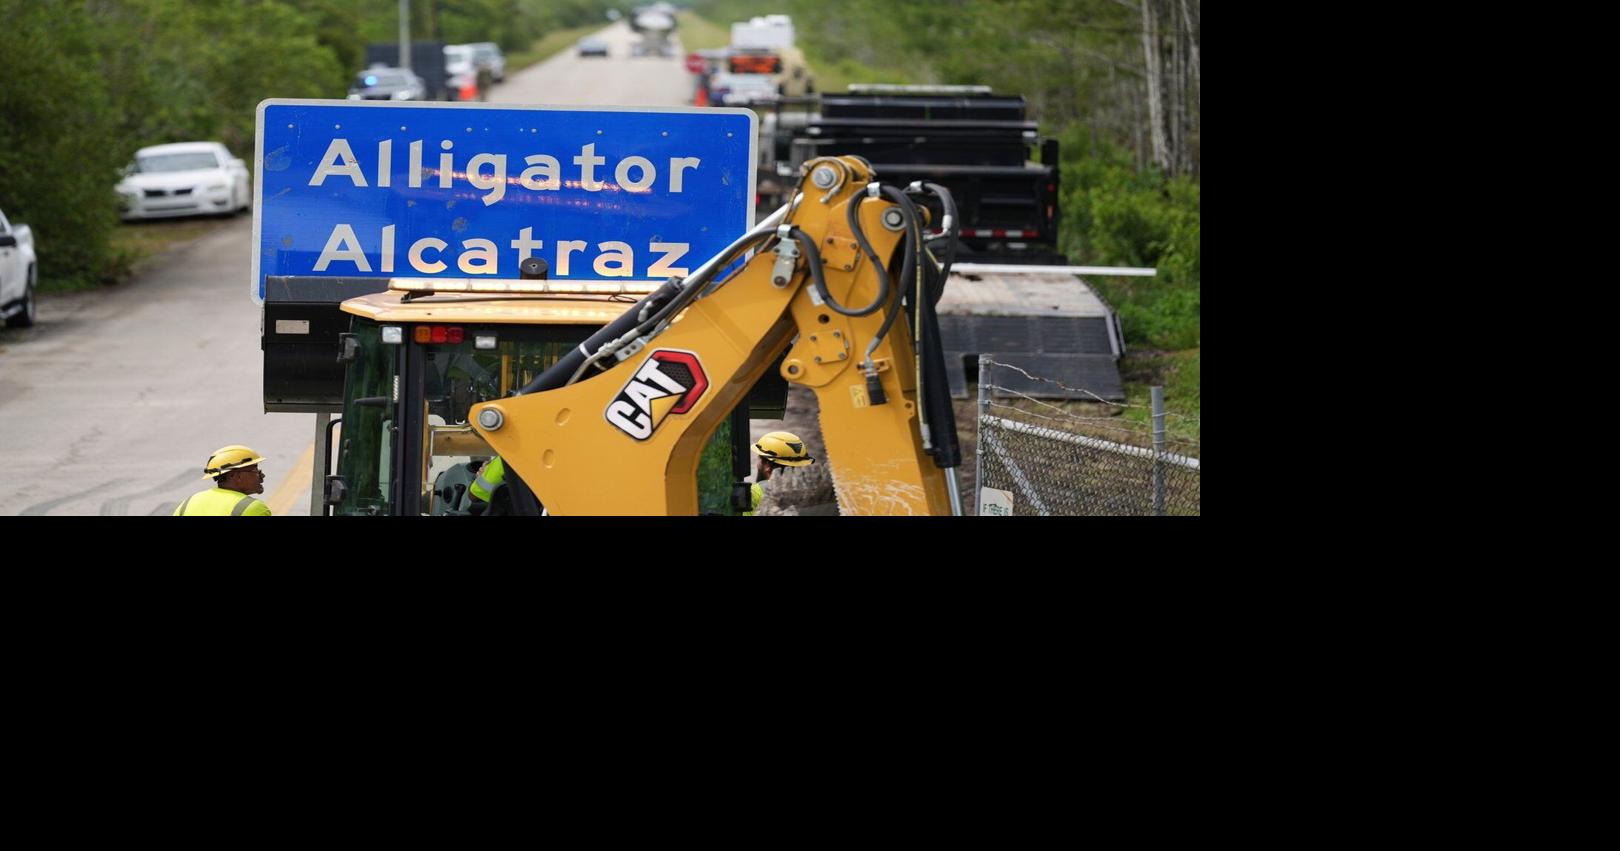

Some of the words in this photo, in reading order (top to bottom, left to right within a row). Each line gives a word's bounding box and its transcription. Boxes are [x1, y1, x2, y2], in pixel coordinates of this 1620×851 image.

[308, 138, 701, 207] Alligator
[312, 223, 690, 278] Alcatraz
[606, 358, 688, 440] CAT
